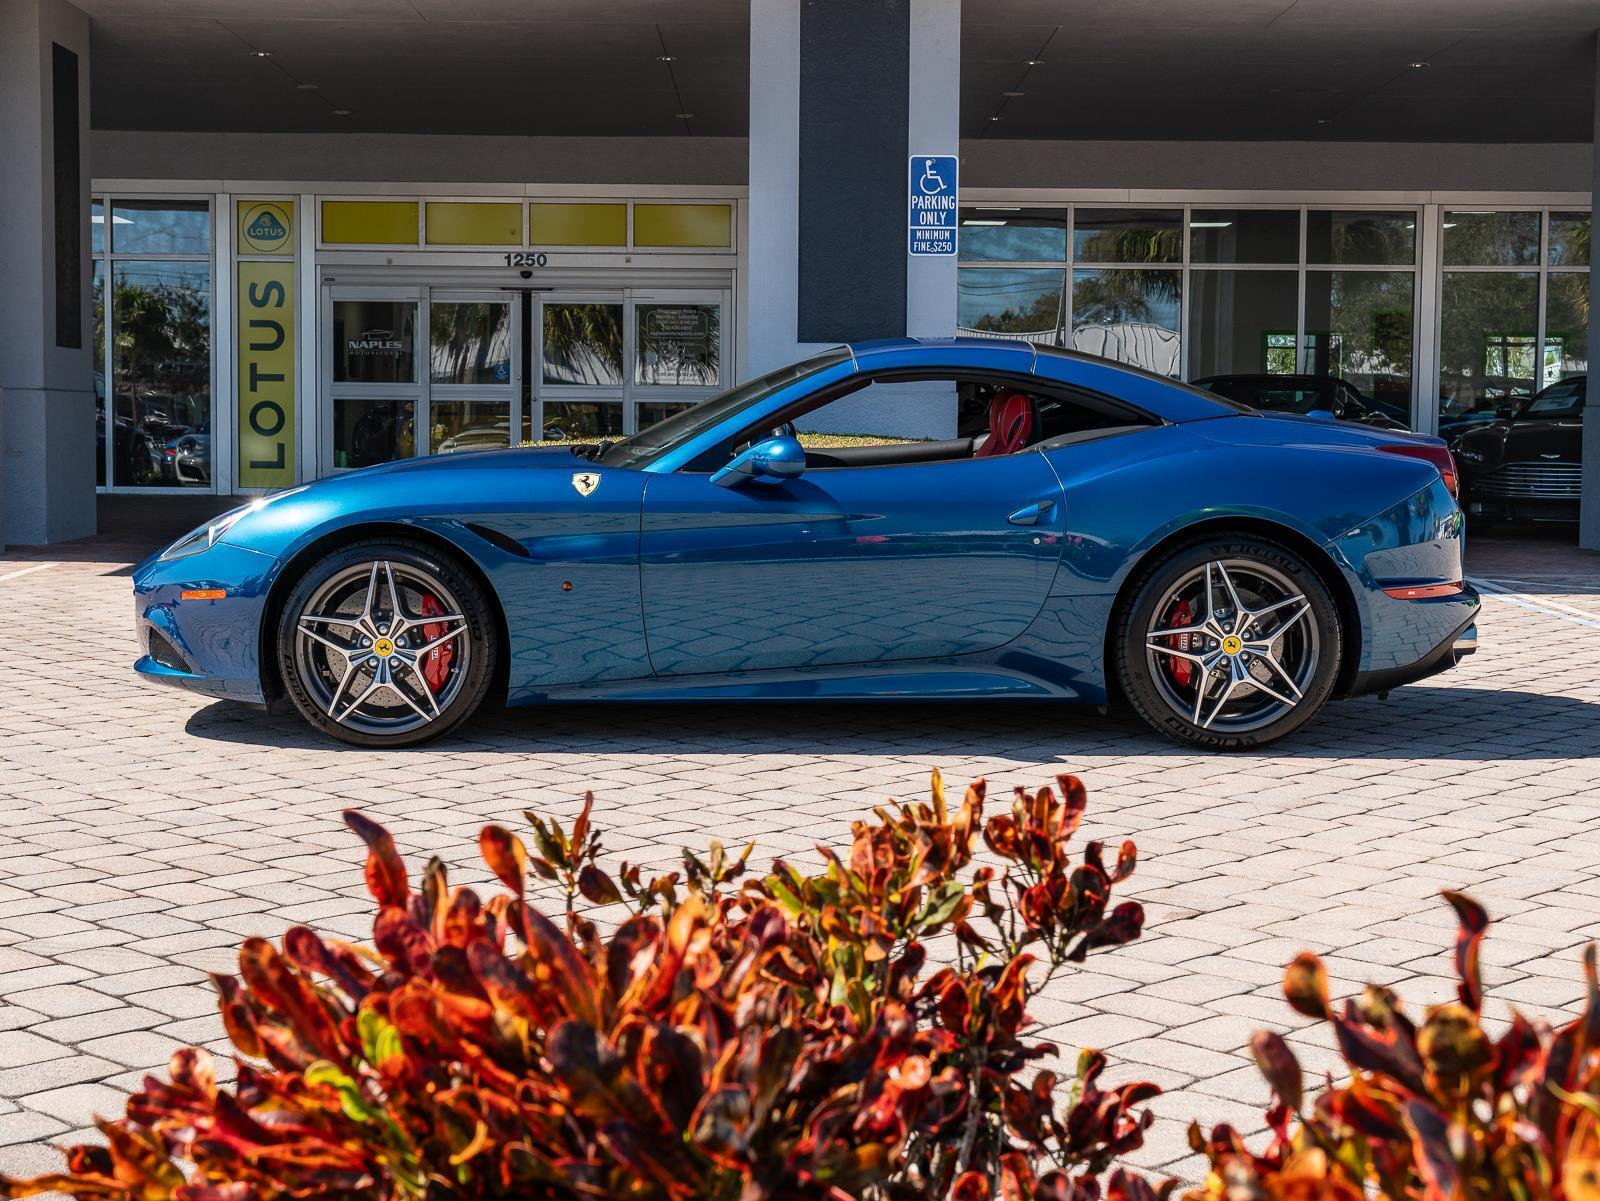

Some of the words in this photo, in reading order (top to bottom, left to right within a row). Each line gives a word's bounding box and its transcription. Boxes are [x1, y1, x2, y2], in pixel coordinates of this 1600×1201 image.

[912, 195, 956, 209] PARKING
[919, 211, 947, 225] ONLY
[250, 227, 284, 236] LOTUS
[916, 230, 950, 240] MINIMUM
[914, 242, 931, 252] FINE
[934, 241, 952, 252] $250
[504, 253, 548, 267] 1250
[348, 340, 403, 349] NAPLES
[249, 280, 285, 470] LOTUS
[1231, 544, 1300, 573] MICHELIN
[1167, 718, 1237, 746] MICHELIN
